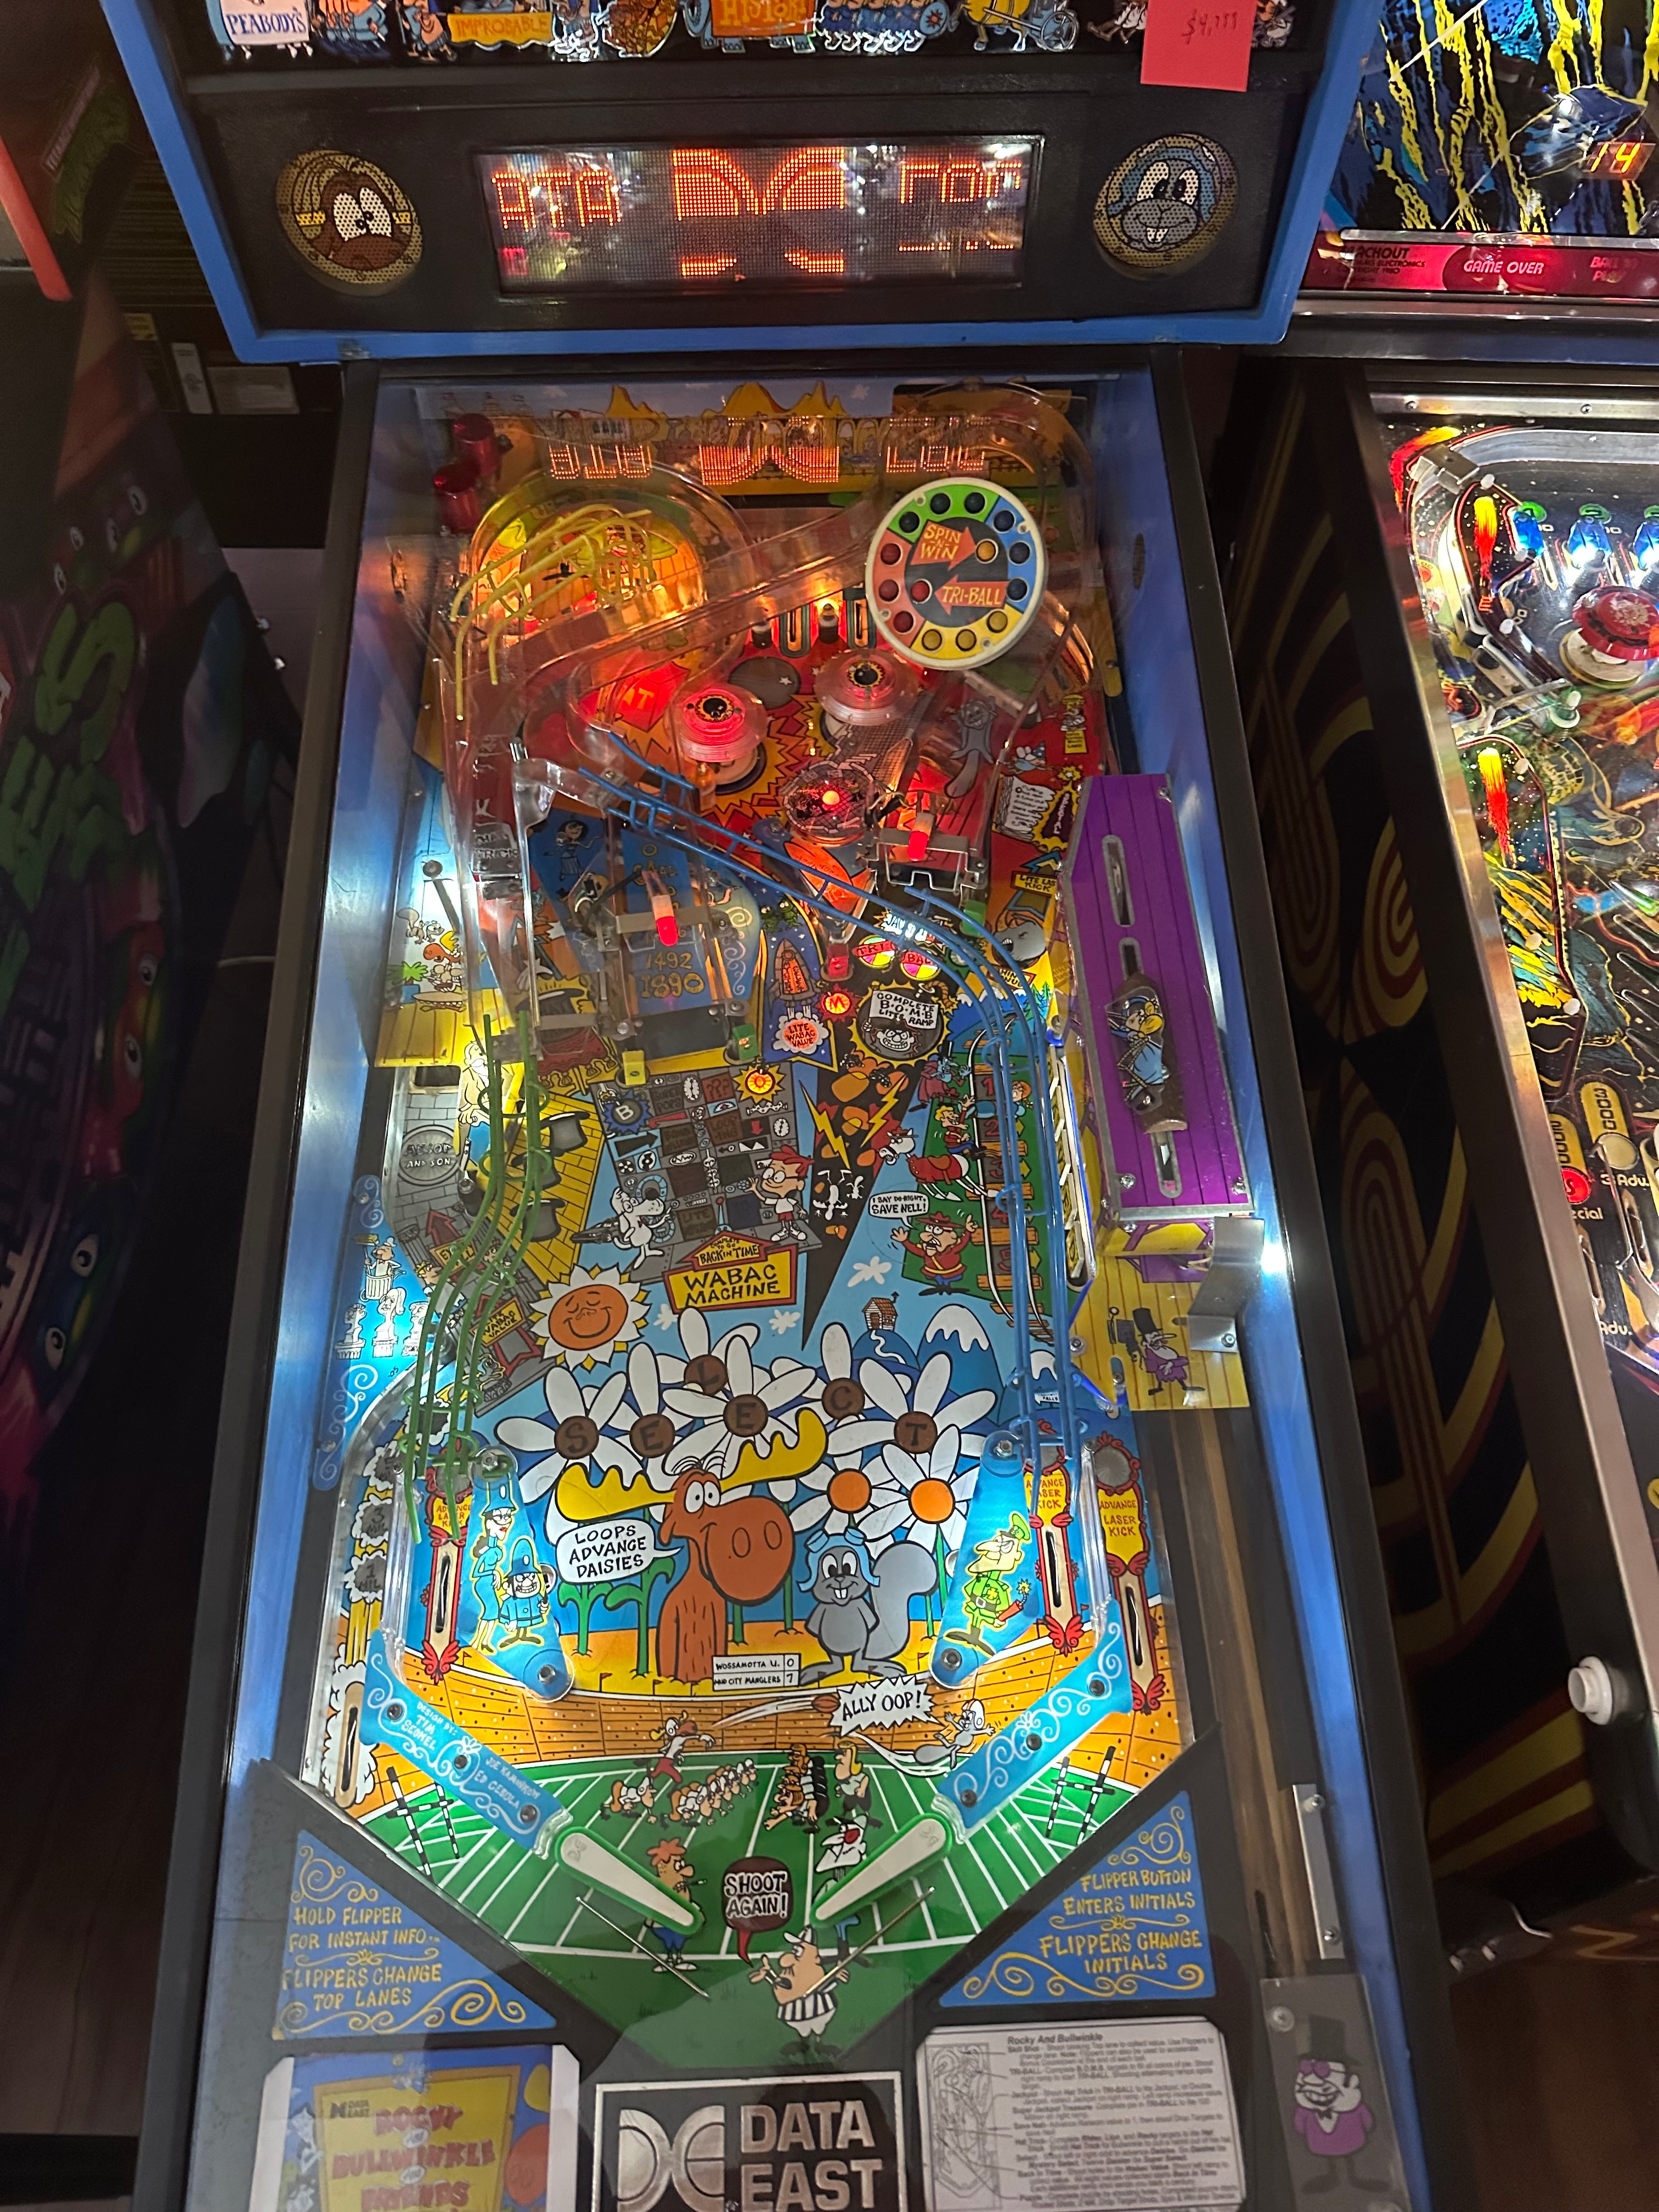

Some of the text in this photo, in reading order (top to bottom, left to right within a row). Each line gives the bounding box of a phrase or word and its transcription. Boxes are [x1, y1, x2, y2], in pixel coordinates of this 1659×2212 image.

[226, 6, 307, 35] PEABODY'S
[456, 16, 548, 37] IMPROBABLE
[1590, 143, 1640, 174] 14
[1463, 259, 1544, 275] GAME OVER
[923, 524, 961, 544] SPIN
[920, 543, 959, 560] WIN
[942, 586, 1002, 606] TRI-BALL
[1019, 874, 1040, 884] LITE
[1024, 882, 1051, 892] KICK
[857, 943, 884, 956] TRI
[646, 952, 693, 970] 1492
[830, 996, 845, 1009] M
[877, 992, 935, 1012] COMPLETE
[788, 1023, 810, 1034] LITE
[908, 1017, 934, 1026] RAMP
[786, 1029, 815, 1042] WABAC
[792, 1037, 814, 1047] VALUE
[615, 1105, 634, 1120] B
[985, 1118, 999, 1136] 2
[405, 1143, 452, 1156] AESOP
[430, 1158, 450, 1167] SON
[1617, 1173, 1650, 1188] Adv.
[871, 1203, 926, 1214] SAVE NELL!
[710, 1238, 740, 1249] COMPLETE
[699, 1249, 724, 1264] BACK
[732, 1244, 760, 1259] TIME
[683, 1263, 777, 1290] WABAC
[684, 1280, 781, 1307] MACHINE
[489, 1318, 517, 1338] VALUE
[830, 1385, 852, 1412] C
[736, 1402, 757, 1429] E
[564, 1421, 589, 1454] S
[639, 1422, 663, 1451] E
[905, 1421, 928, 1447] T
[1100, 1499, 1137, 1510] ADVANCE
[371, 1512, 383, 1524] 3
[1103, 1515, 1137, 1525] LASER
[575, 1525, 636, 1544] LOOPS
[1108, 1526, 1136, 1537] KICK
[568, 1537, 647, 1565] ADVANCE
[365, 1564, 376, 1579] 1
[576, 1554, 644, 1578] DAISIES
[358, 1578, 381, 1592] MIL
[715, 1661, 766, 1671] WOSSAMOTTA
[728, 1677, 742, 1685] CITY
[744, 1675, 781, 1685] MANGLERS
[786, 1673, 793, 1684] 7
[416, 1701, 443, 1725] DESIGN
[842, 1689, 922, 1721] ALLY OOP!
[416, 1714, 436, 1735] TIM
[473, 1770, 488, 1784] ED
[725, 1870, 788, 1895] SHOOT
[1080, 1869, 1191, 1893] FLIPPER BUTTON
[725, 1893, 789, 1918] AGAIN!
[1063, 1892, 1195, 1916] ENTERS INITIALS
[294, 1905, 402, 1926] HOLD FLIPPER
[289, 1933, 320, 1953] FOR
[328, 1929, 388, 1949] INSTANT
[1040, 1929, 1203, 1959] FLIPPERS CHANGE
[1084, 1953, 1167, 1973] INITIALS
[281, 1963, 442, 1990] FLIPPERS CHANGE
[313, 1988, 411, 2012] TOP LANES
[375, 2103, 464, 2136] ROCKY
[740, 2100, 876, 2154] DATA
[332, 2138, 496, 2180] BULLWINKLE
[740, 2158, 883, 2212] EAST
